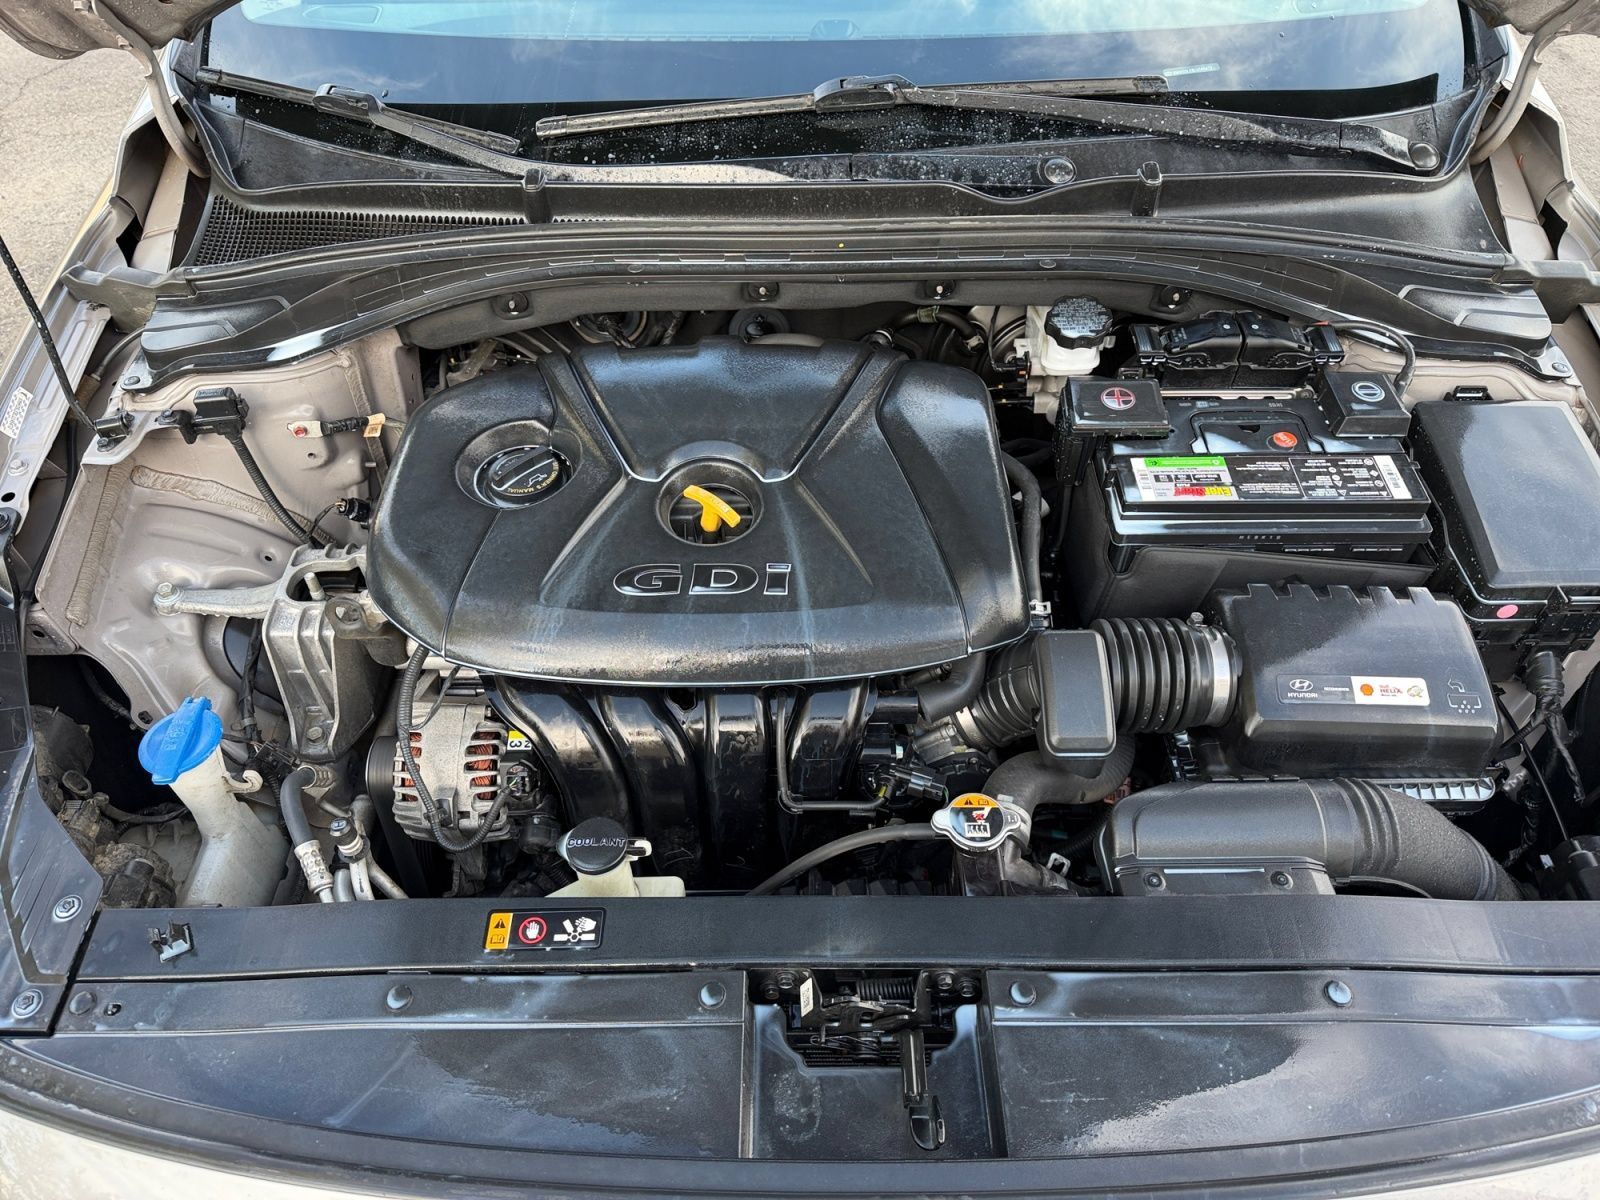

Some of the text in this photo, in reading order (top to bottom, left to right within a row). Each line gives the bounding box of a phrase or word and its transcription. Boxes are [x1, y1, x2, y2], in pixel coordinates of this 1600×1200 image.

[1174, 487, 1233, 497] EverStart
[613, 563, 792, 597] GDi
[567, 837, 626, 848] COOLANT
